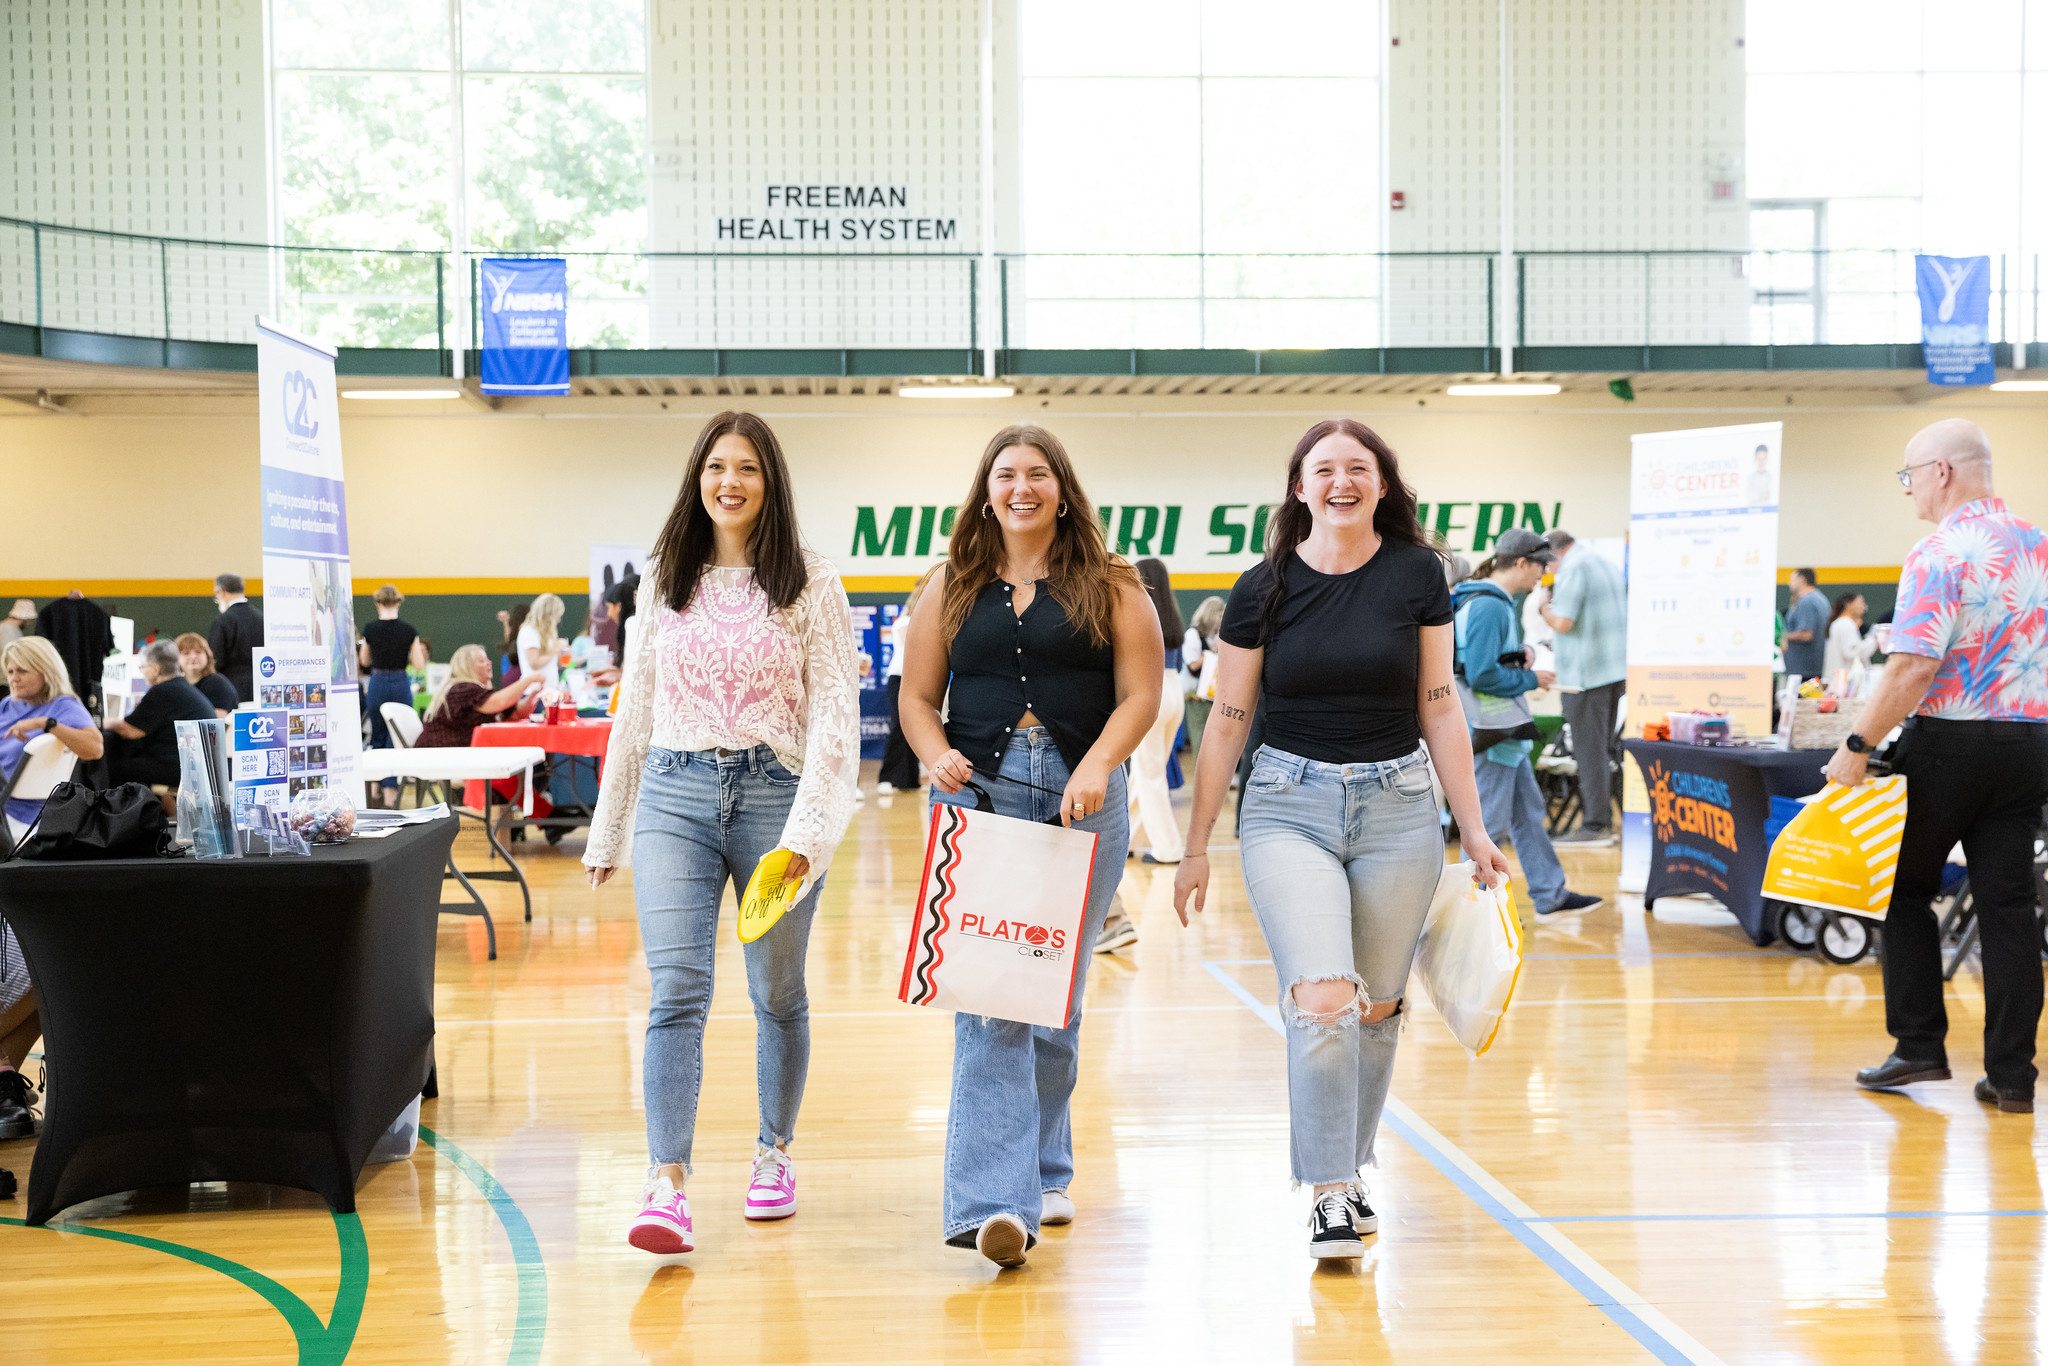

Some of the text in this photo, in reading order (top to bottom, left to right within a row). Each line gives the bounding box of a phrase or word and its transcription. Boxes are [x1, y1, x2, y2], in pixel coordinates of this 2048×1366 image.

[767, 186, 907, 208] FREEMAN
[717, 218, 957, 240] HEALTH SYSTEM
[1675, 472, 1739, 493] CENTER
[278, 658, 326, 667] PERFORMANCES
[1427, 683, 1451, 702] 1974
[1220, 702, 1246, 722] 1972
[248, 716, 275, 739] C2C
[241, 755, 258, 763] SCAN
[242, 765, 258, 773] HERE
[263, 789, 280, 797] SCAN
[1674, 796, 1738, 853] CENTER
[960, 912, 1066, 949] PLATO'S
[1017, 946, 1064, 961] CLOSET
